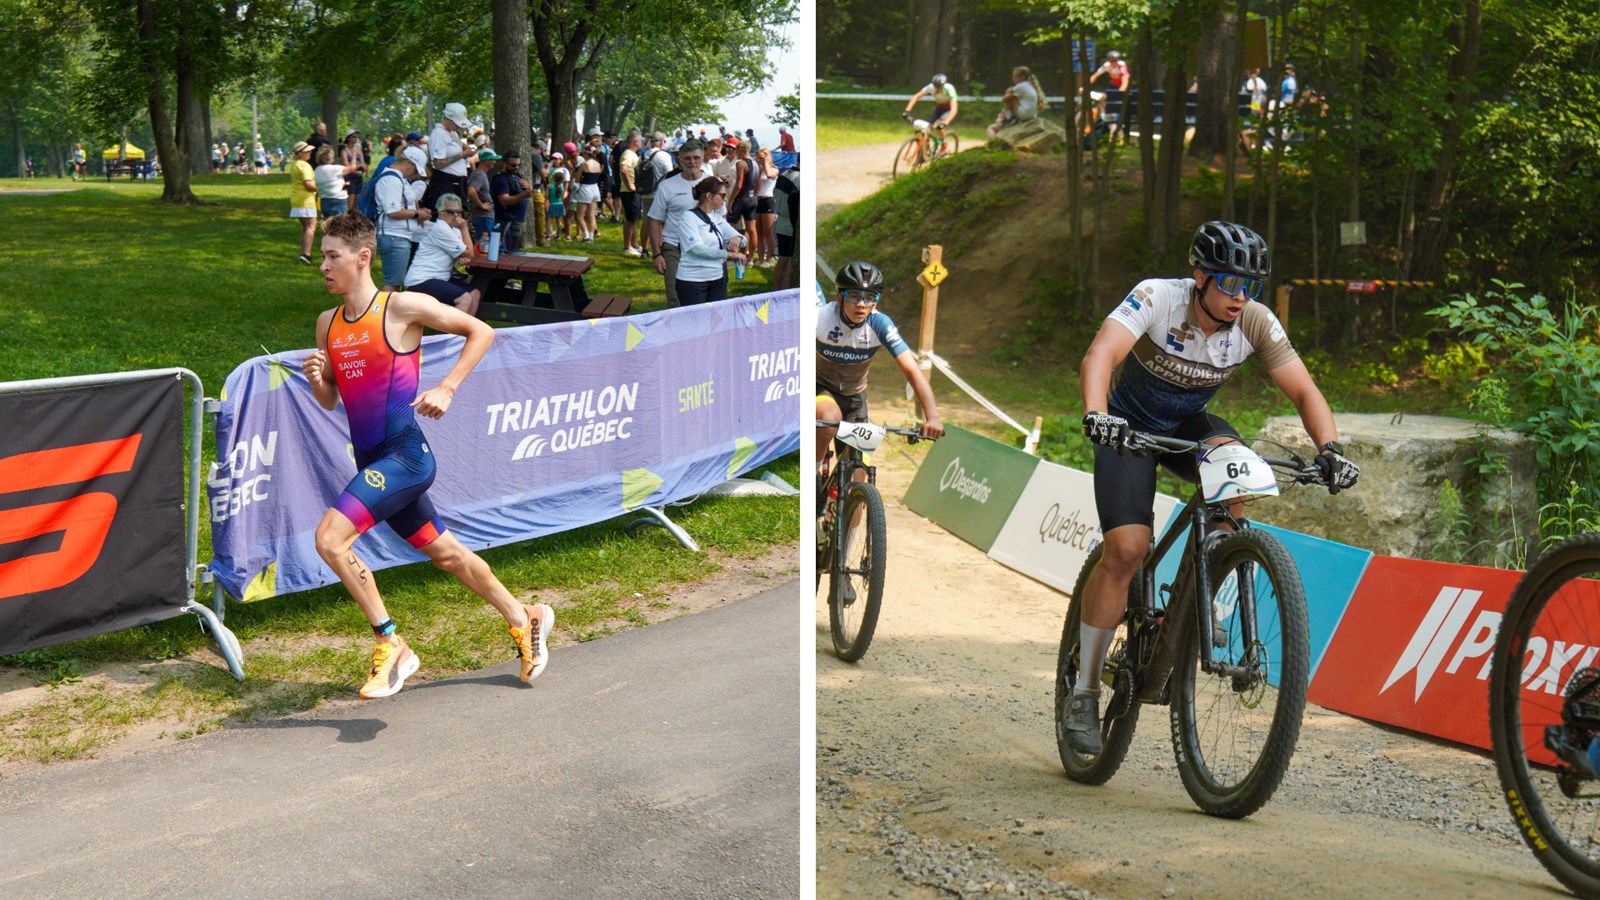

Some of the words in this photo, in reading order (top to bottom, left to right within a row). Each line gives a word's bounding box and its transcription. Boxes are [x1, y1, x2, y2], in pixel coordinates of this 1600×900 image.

[338, 359, 367, 371] SAVOIE
[345, 368, 364, 379] CAN
[486, 382, 639, 435] TRIATHLON
[678, 373, 714, 413] SANTÉ
[551, 418, 633, 453] QUÉBEC
[851, 424, 873, 441] 203
[951, 467, 992, 504] Desjardins
[1226, 462, 1251, 479] 64
[1039, 503, 1094, 550] Québec
[347, 554, 367, 586] 45
[1172, 711, 1186, 762] MAXXIS
[1507, 789, 1548, 851] MAXXIS
